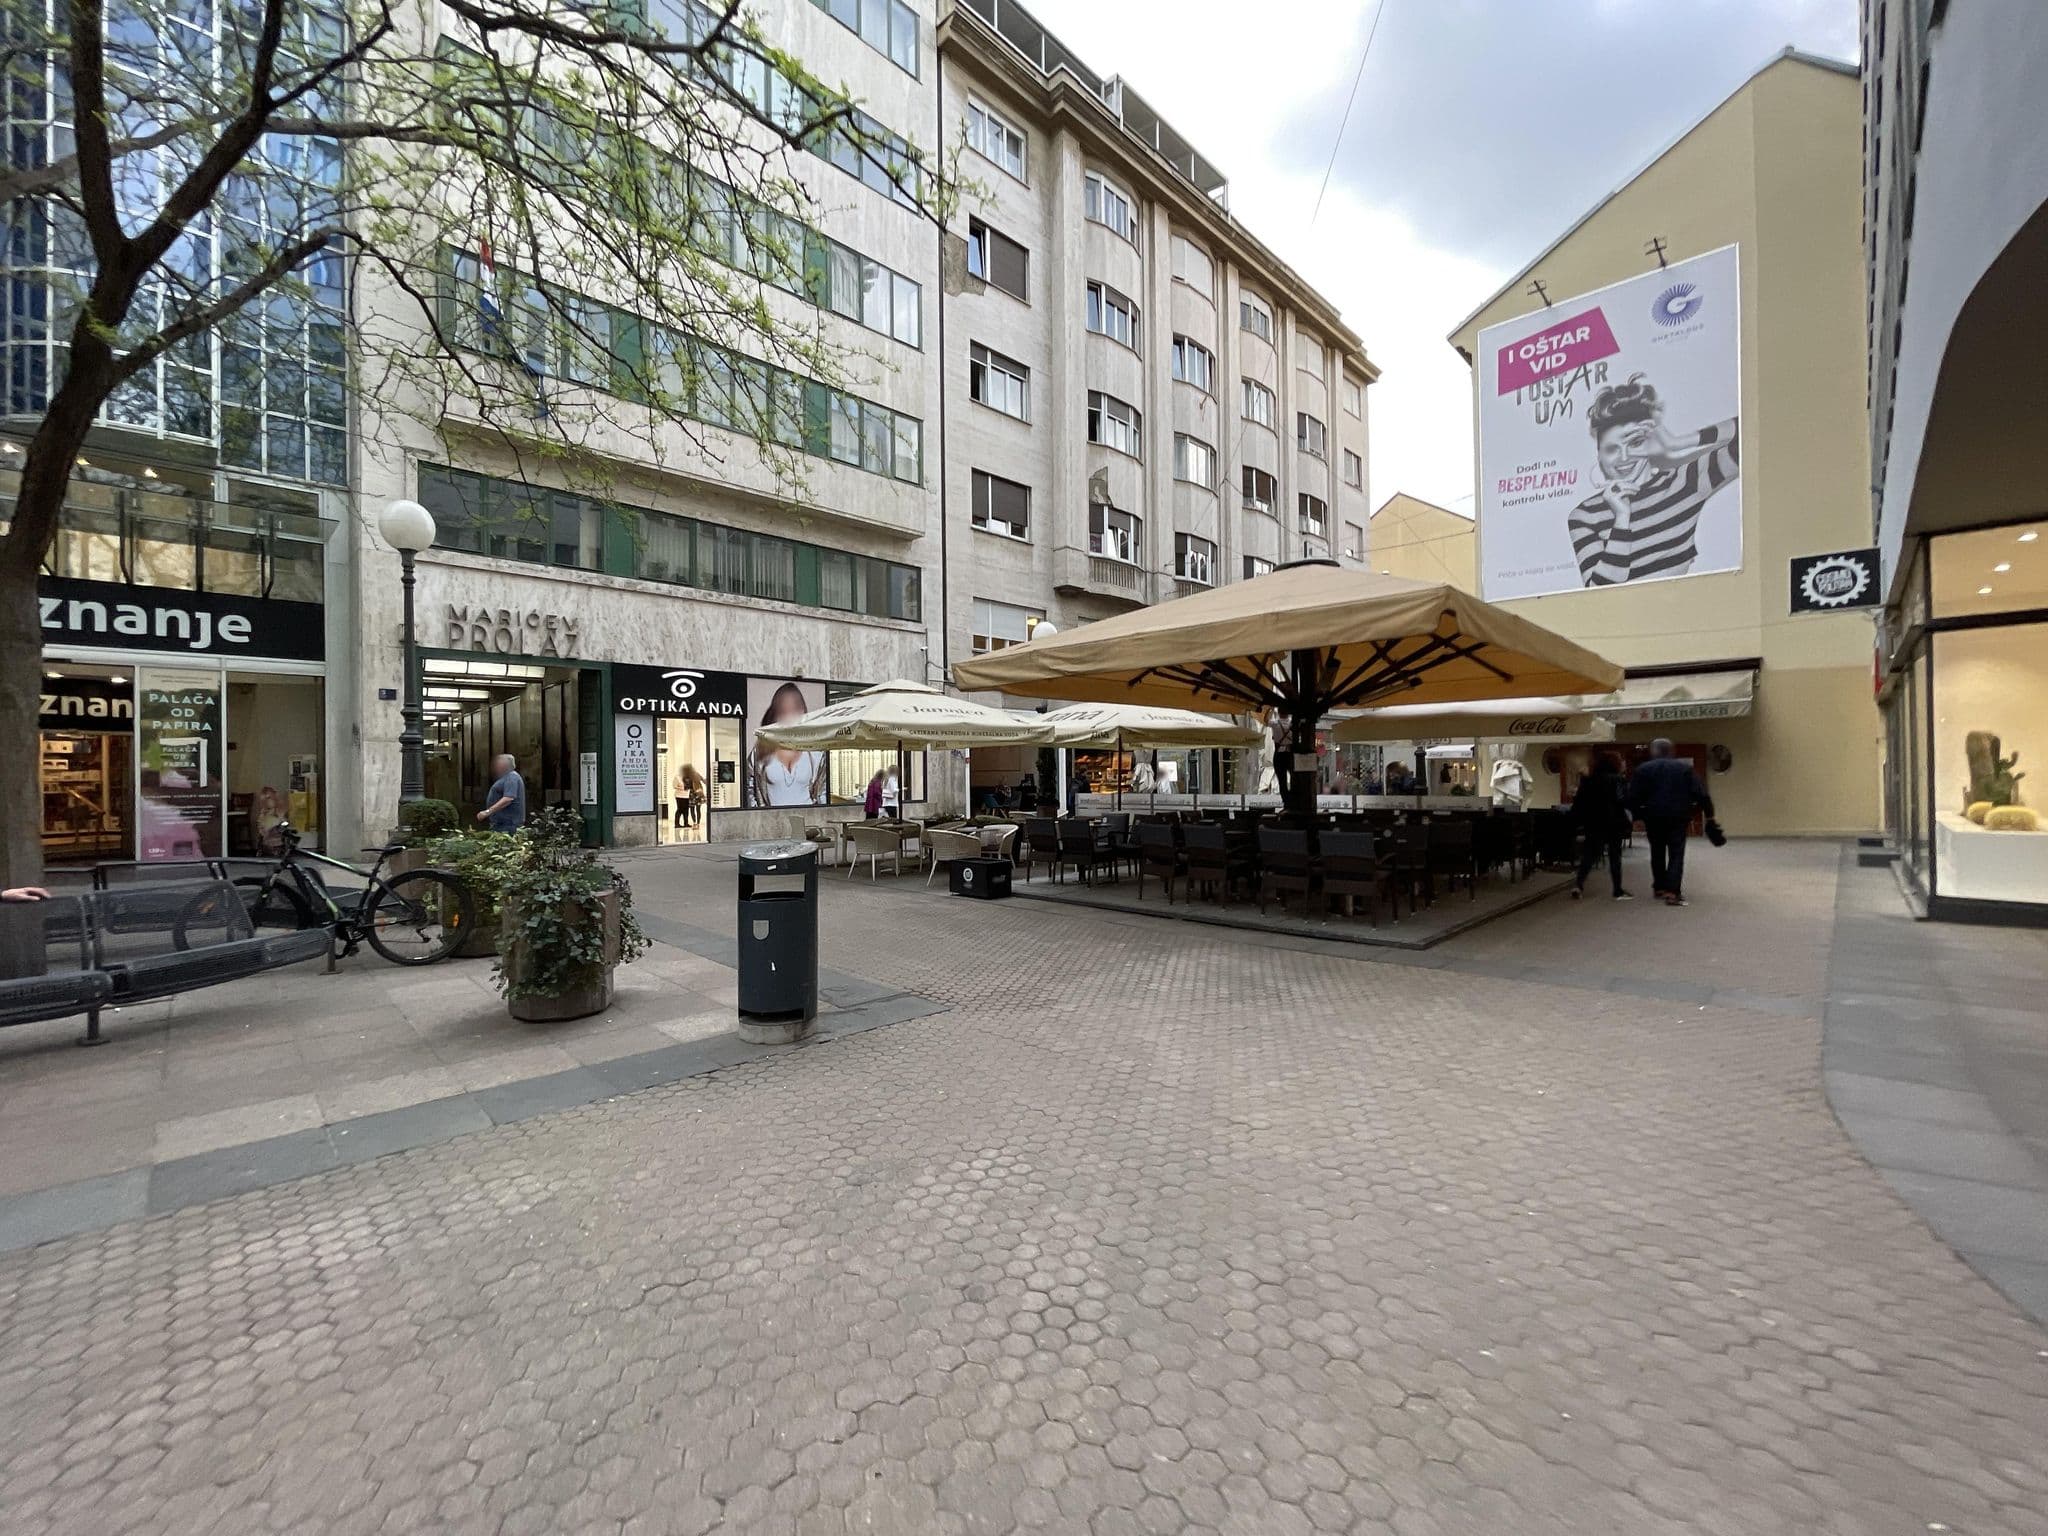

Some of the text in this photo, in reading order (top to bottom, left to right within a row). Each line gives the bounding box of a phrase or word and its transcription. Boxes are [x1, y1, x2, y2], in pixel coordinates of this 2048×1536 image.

[1508, 326, 1591, 364] I OŠTAR
[1529, 352, 1567, 374] VID
[1535, 398, 1573, 427] UM
[1543, 459, 1557, 469] na
[1497, 469, 1578, 494] BESPLATNU
[1502, 493, 1545, 508] kontrolu
[39, 597, 252, 648] znanje
[448, 602, 578, 632] MARIĆEV
[447, 622, 578, 660] PROLAZ
[149, 693, 215, 705] PALAČA
[620, 697, 744, 715] OPTIKA ANDA
[171, 708, 195, 718] OD
[1653, 704, 1729, 721] Heineken
[152, 720, 213, 731] PAPIRA
[627, 724, 642, 738] O
